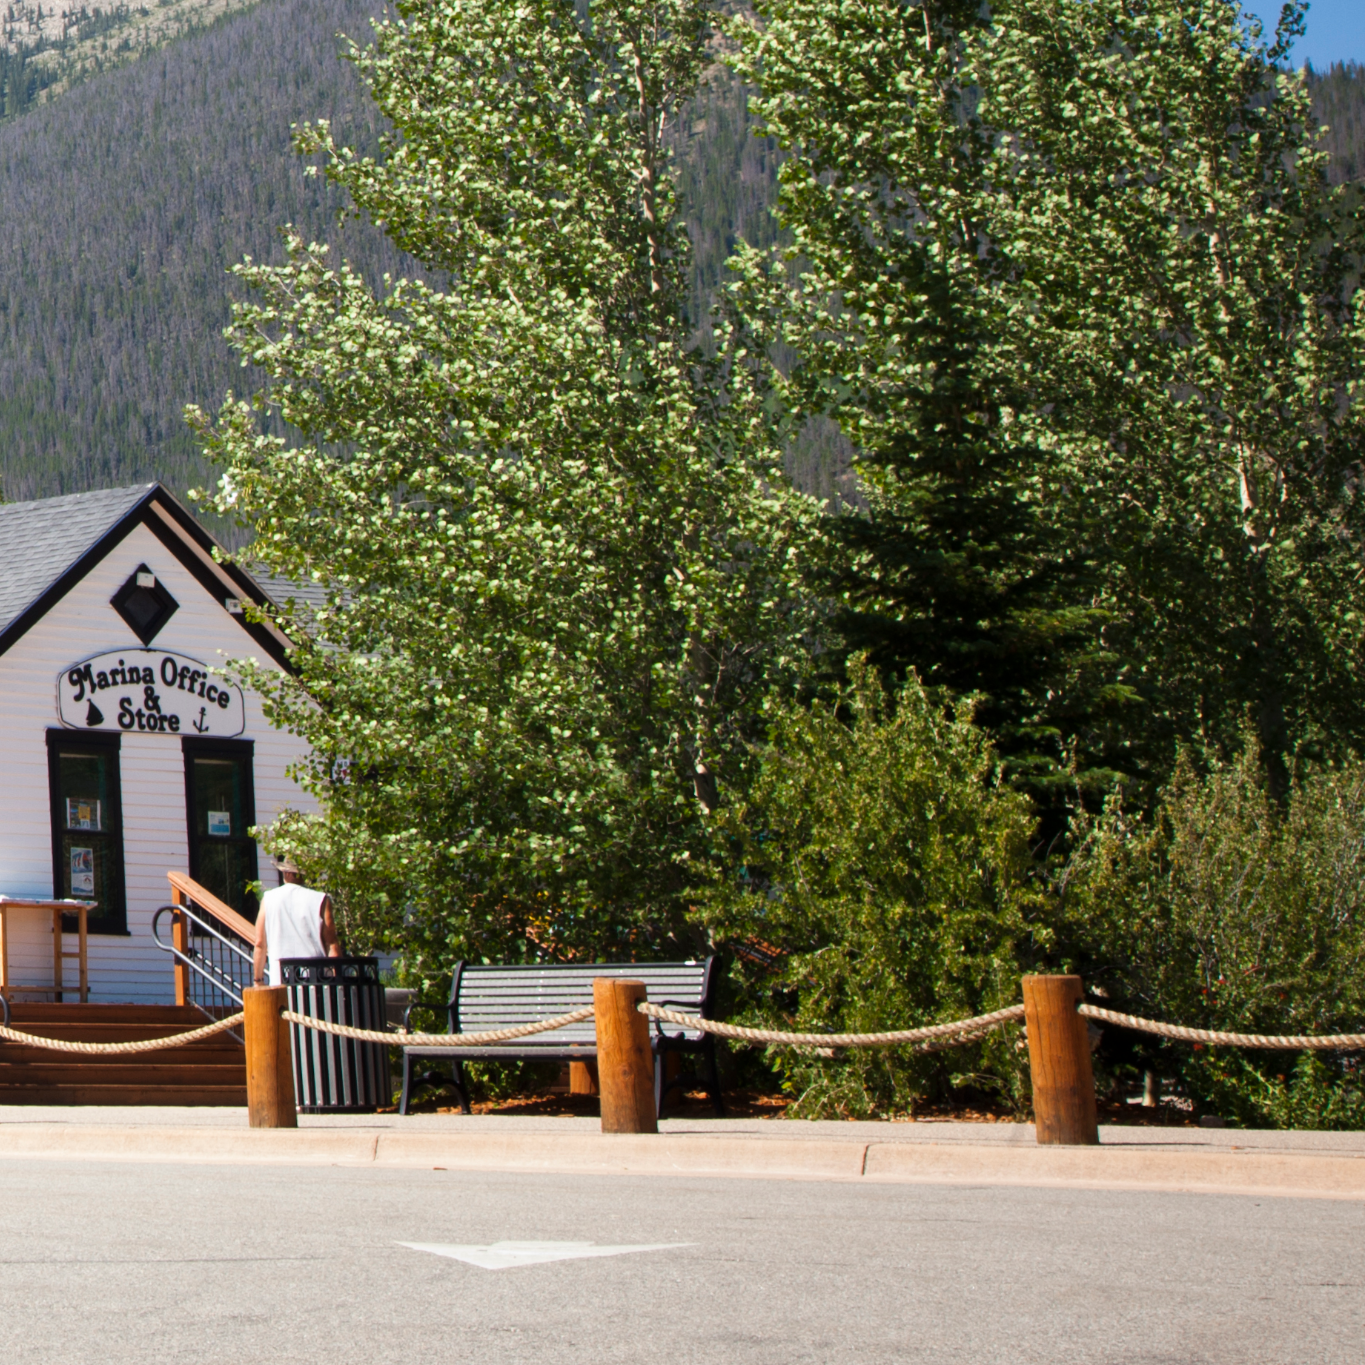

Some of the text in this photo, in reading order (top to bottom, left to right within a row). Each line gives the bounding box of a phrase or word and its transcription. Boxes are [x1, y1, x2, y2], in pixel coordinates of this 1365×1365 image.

[68, 657, 230, 709] Marina Office
[143, 685, 161, 714] &
[117, 697, 180, 732] Store
